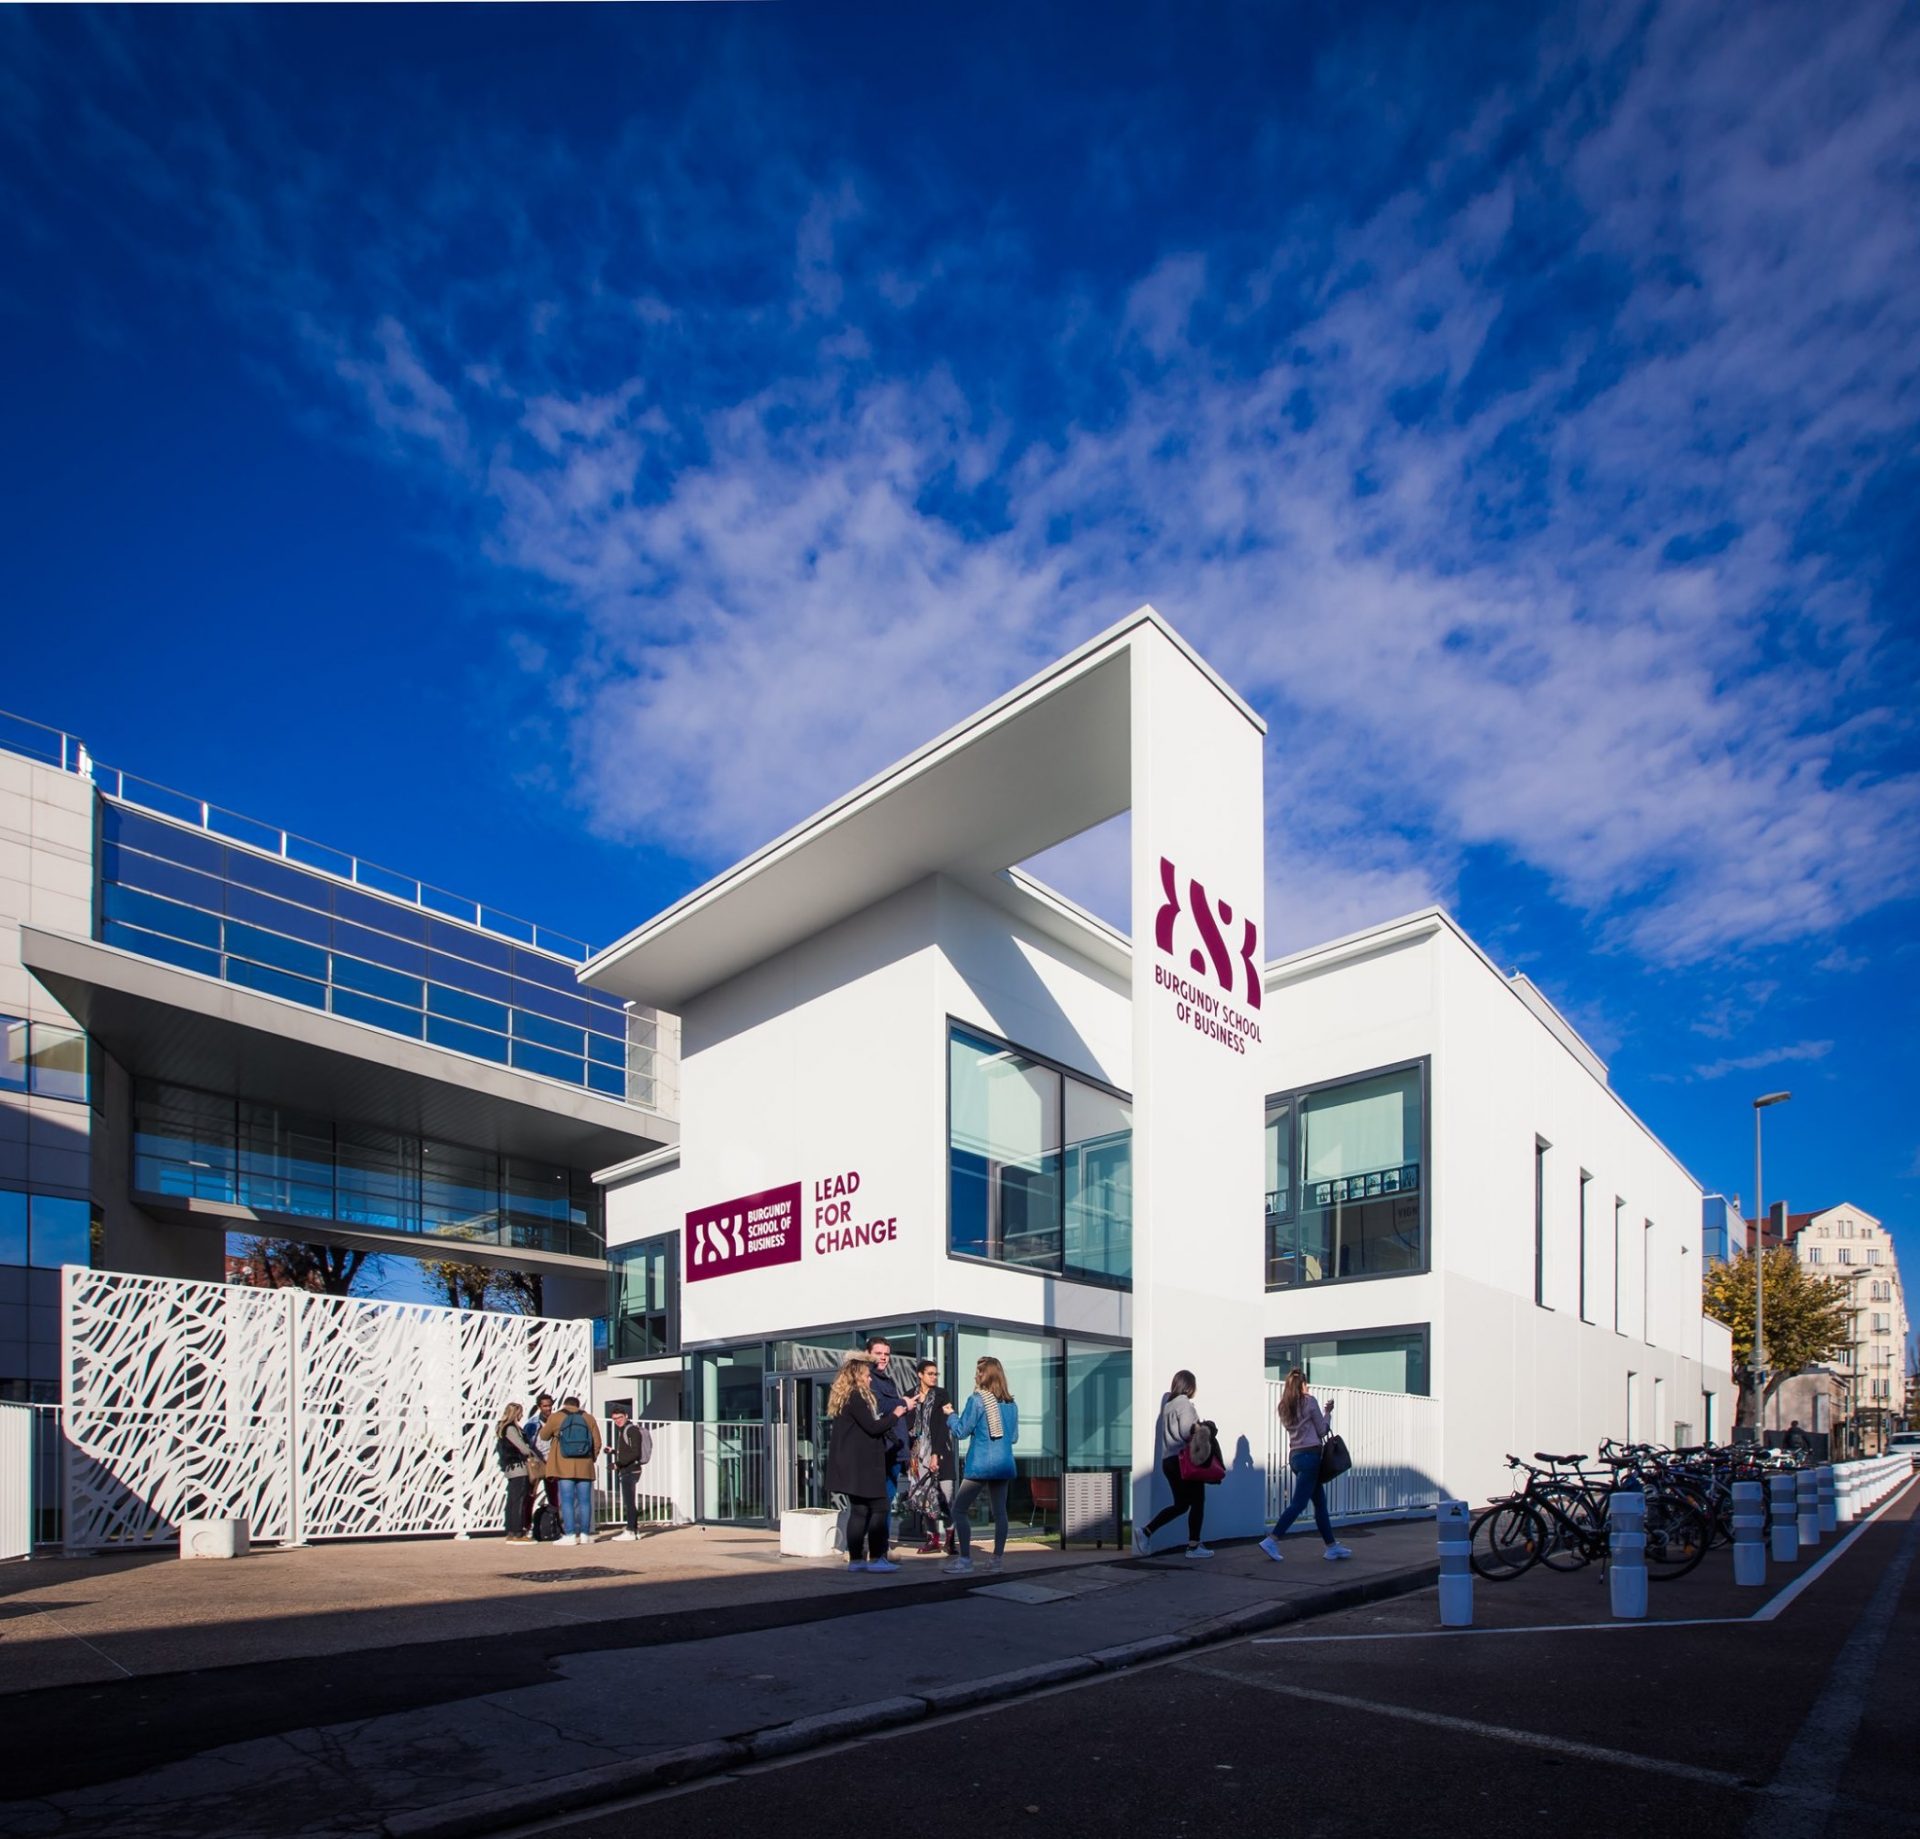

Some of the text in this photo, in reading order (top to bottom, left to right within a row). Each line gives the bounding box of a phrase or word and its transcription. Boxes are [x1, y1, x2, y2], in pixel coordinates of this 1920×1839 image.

[1155, 964, 1262, 1043] BURGUNDY SCHOOL
[1177, 1002, 1245, 1055] OF BUSINESS
[815, 1171, 860, 1202] LEAD
[747, 1200, 792, 1222] BURGUNDY
[815, 1200, 852, 1229] FOR
[747, 1216, 792, 1239] SCHOOL OF
[815, 1217, 897, 1255] CHANGE
[747, 1233, 785, 1253] BUSINESS
